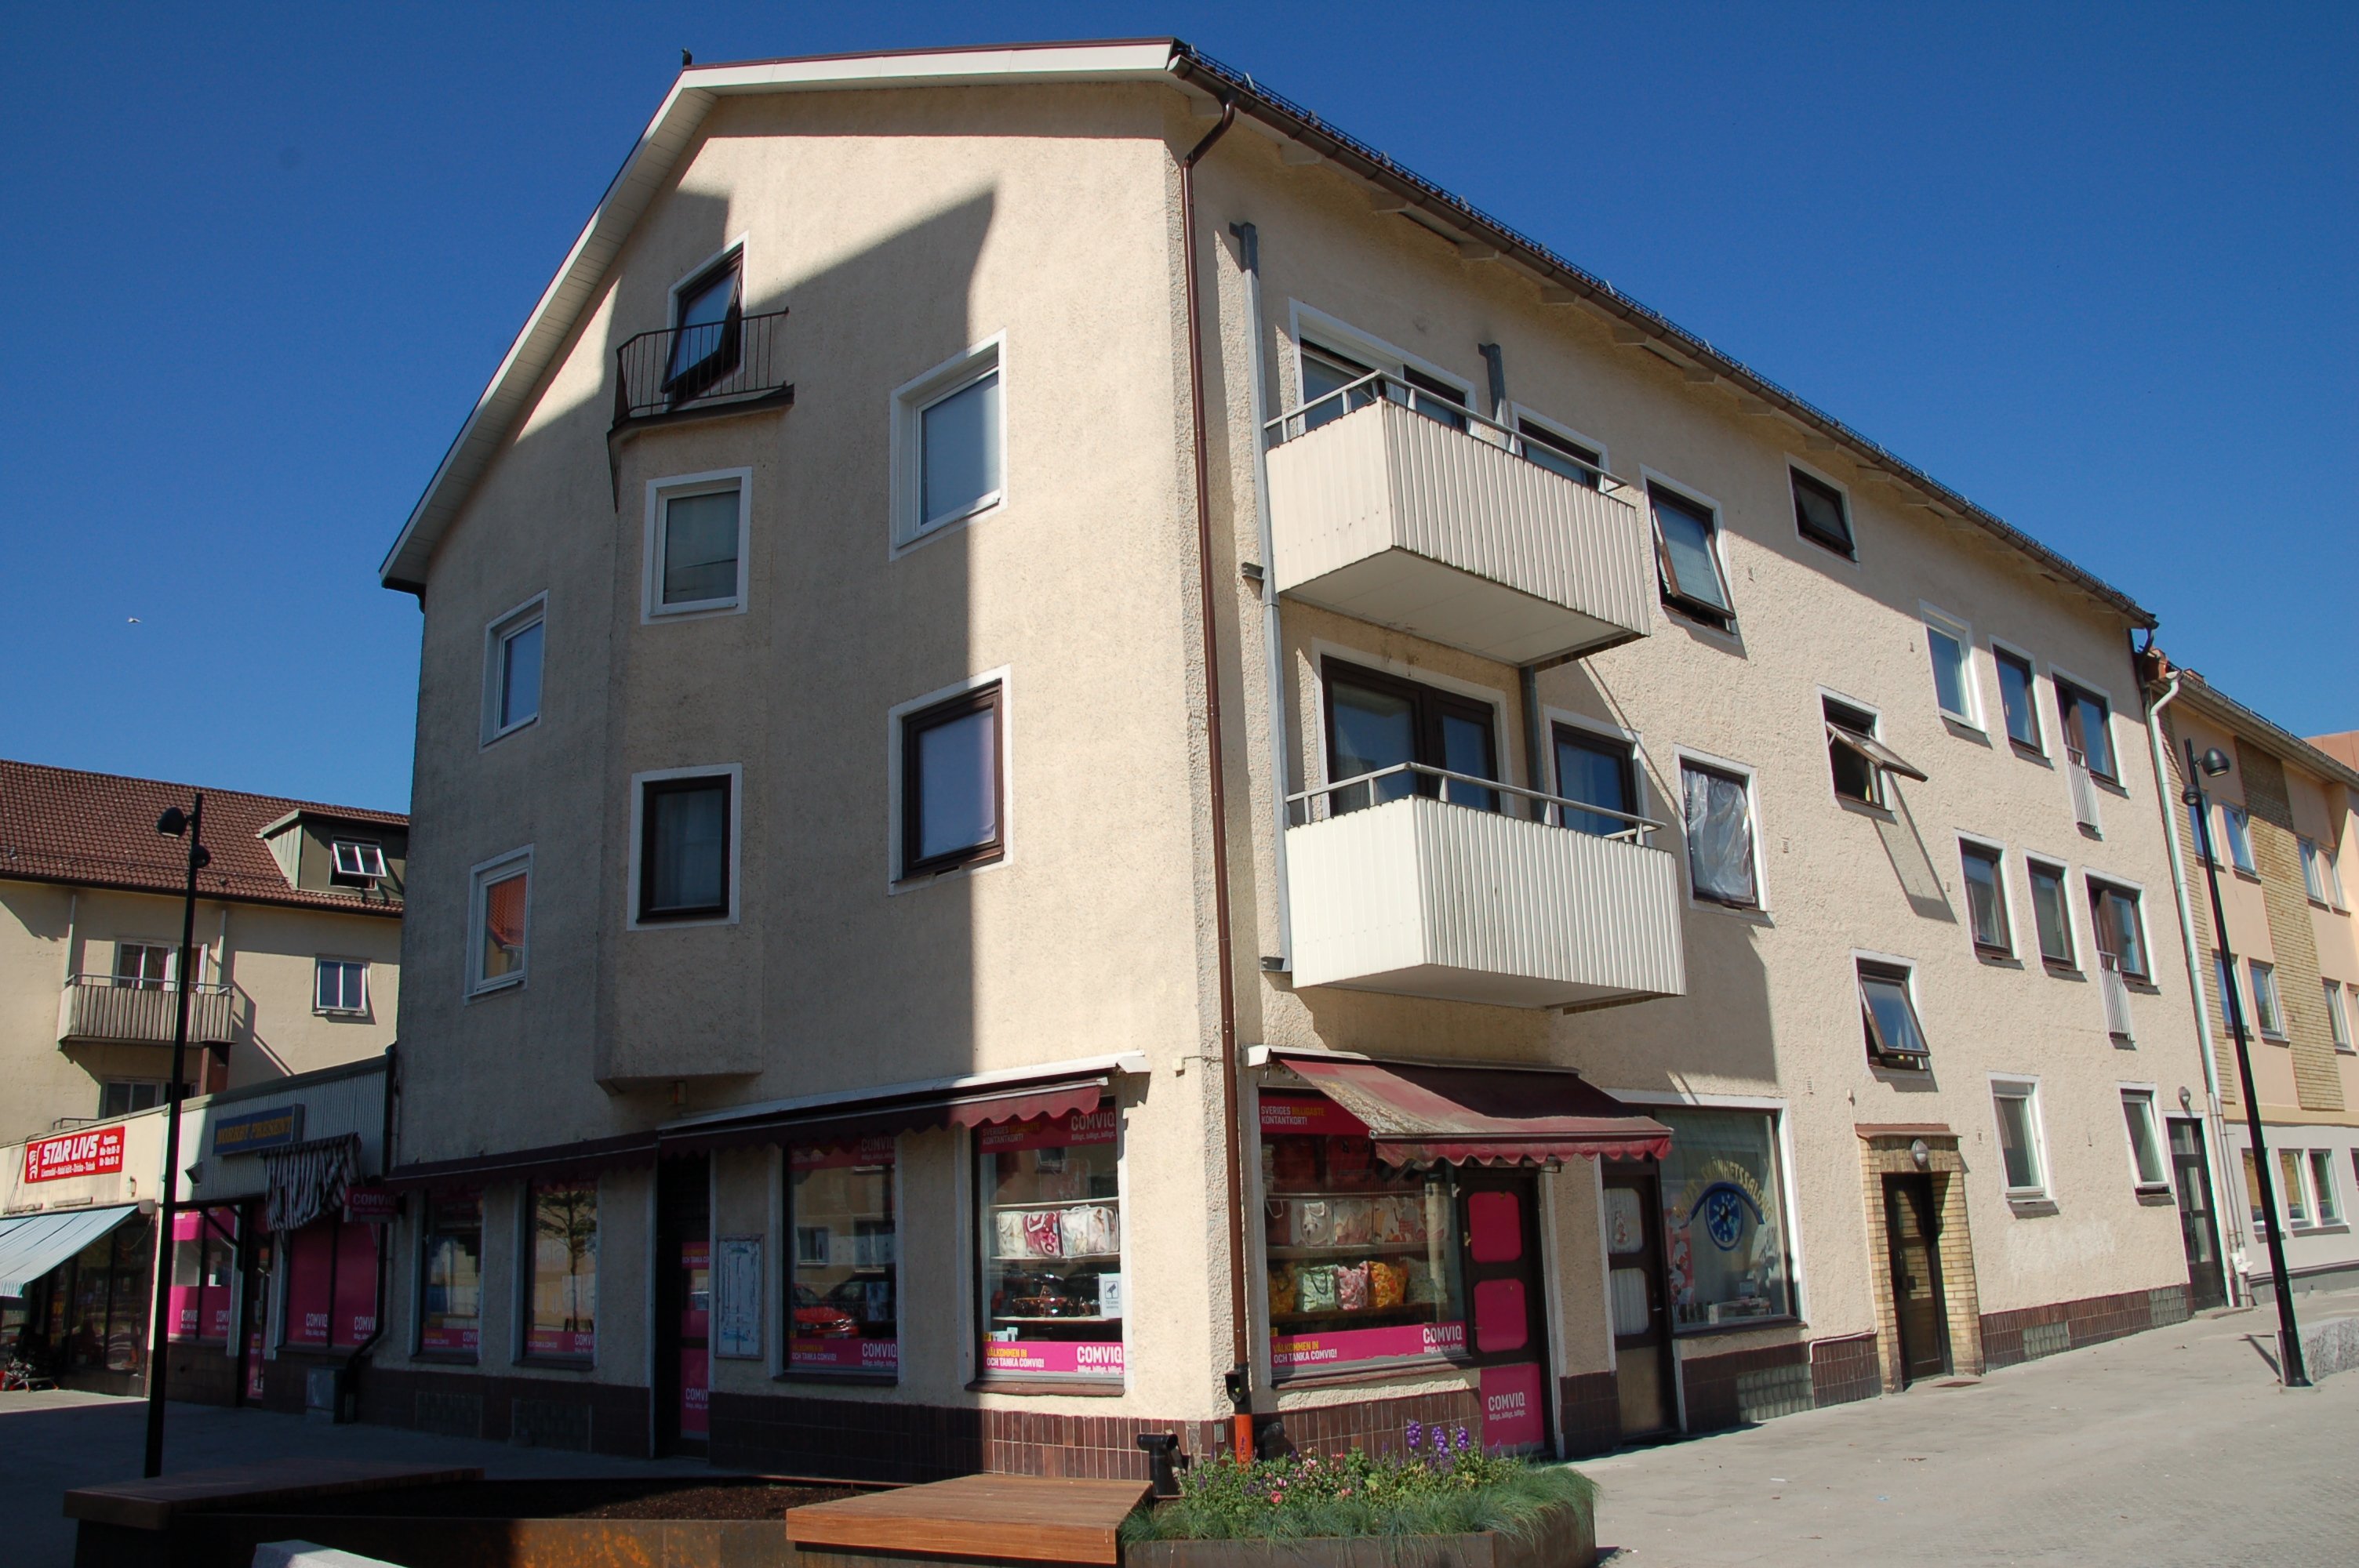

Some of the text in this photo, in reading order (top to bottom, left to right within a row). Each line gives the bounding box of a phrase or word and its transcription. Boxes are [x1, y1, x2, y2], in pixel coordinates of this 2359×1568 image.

[1261, 1105, 1291, 1116] SVERIGES
[1071, 1112, 1116, 1131] COMVIQ
[1261, 1116, 1307, 1125] KONTANTKORT!
[42, 1139, 72, 1166] STAR
[71, 1134, 100, 1160] LIVS
[354, 1316, 376, 1331] COMVI
[575, 1333, 594, 1346] COMVI
[1423, 1325, 1463, 1344] COMVIQ
[862, 1342, 897, 1358] COMVIQ
[1077, 1345, 1123, 1363] COMVIQ
[1274, 1340, 1319, 1354] VÄLKOMMEN IN
[987, 1357, 998, 1367] OCH
[1274, 1348, 1337, 1364] OCH TANKA COMVIQ!
[685, 1388, 708, 1402] COMVI
[1488, 1392, 1525, 1411] COMVIQ
